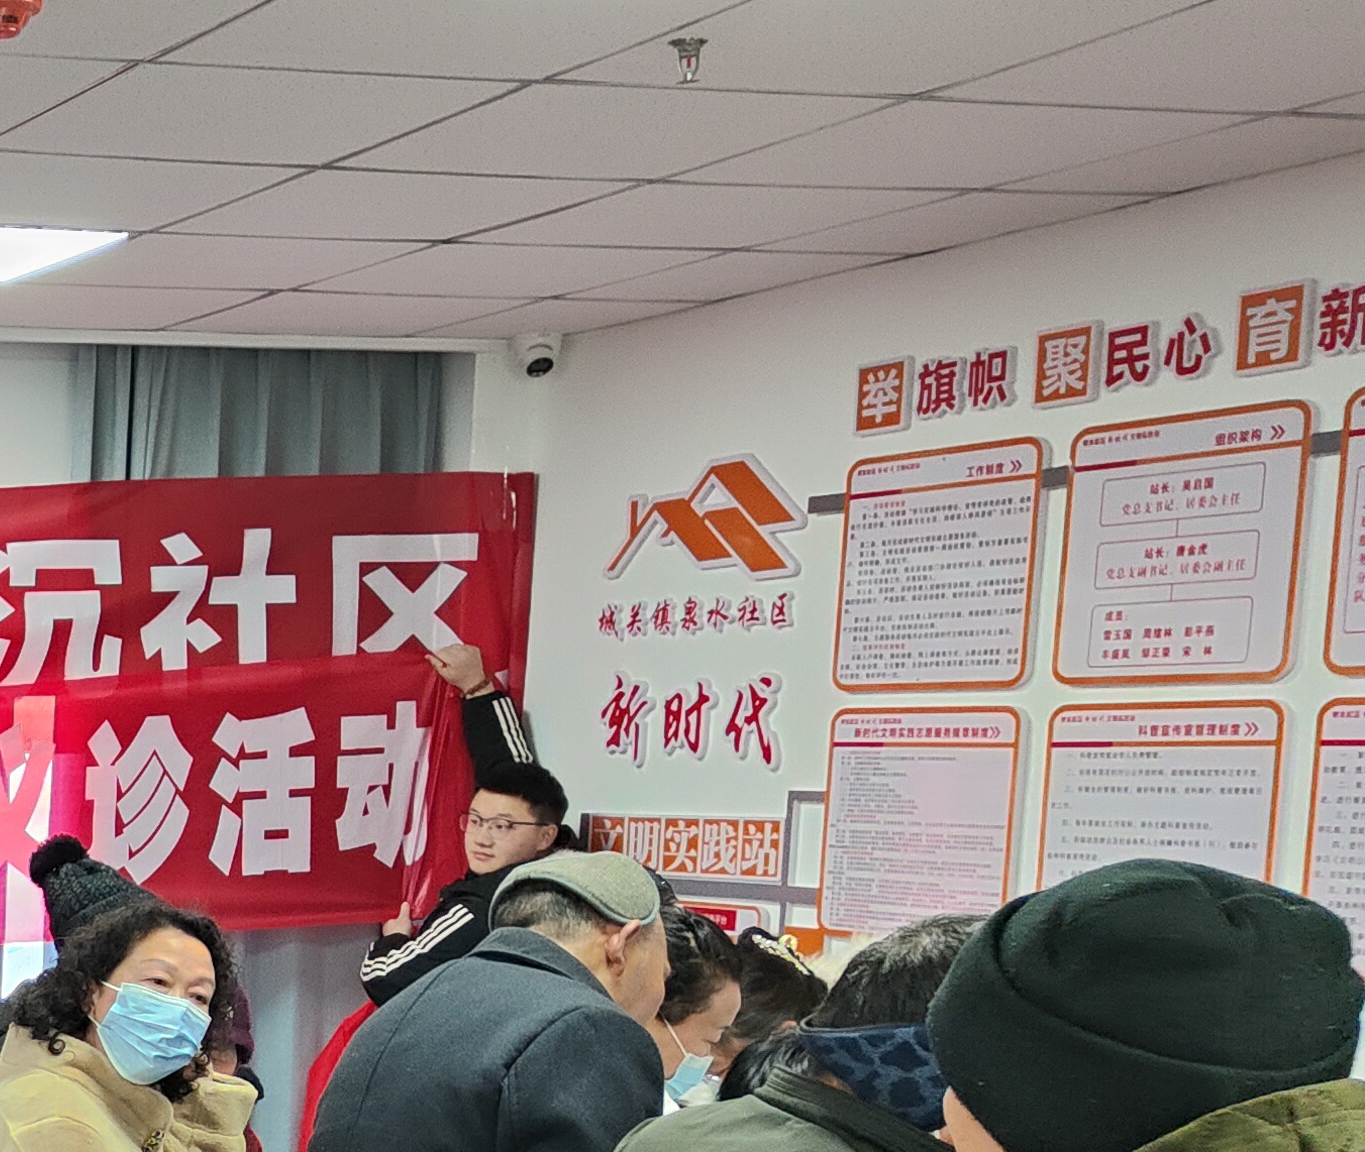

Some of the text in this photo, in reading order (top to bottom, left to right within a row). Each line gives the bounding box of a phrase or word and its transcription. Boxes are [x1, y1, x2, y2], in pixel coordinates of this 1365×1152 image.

[859, 350, 1010, 424] 举旗帜
[1039, 317, 1213, 398] 聚民心
[598, 592, 789, 638] 城关镇泉水社区
[601, 674, 773, 766] 新时代
